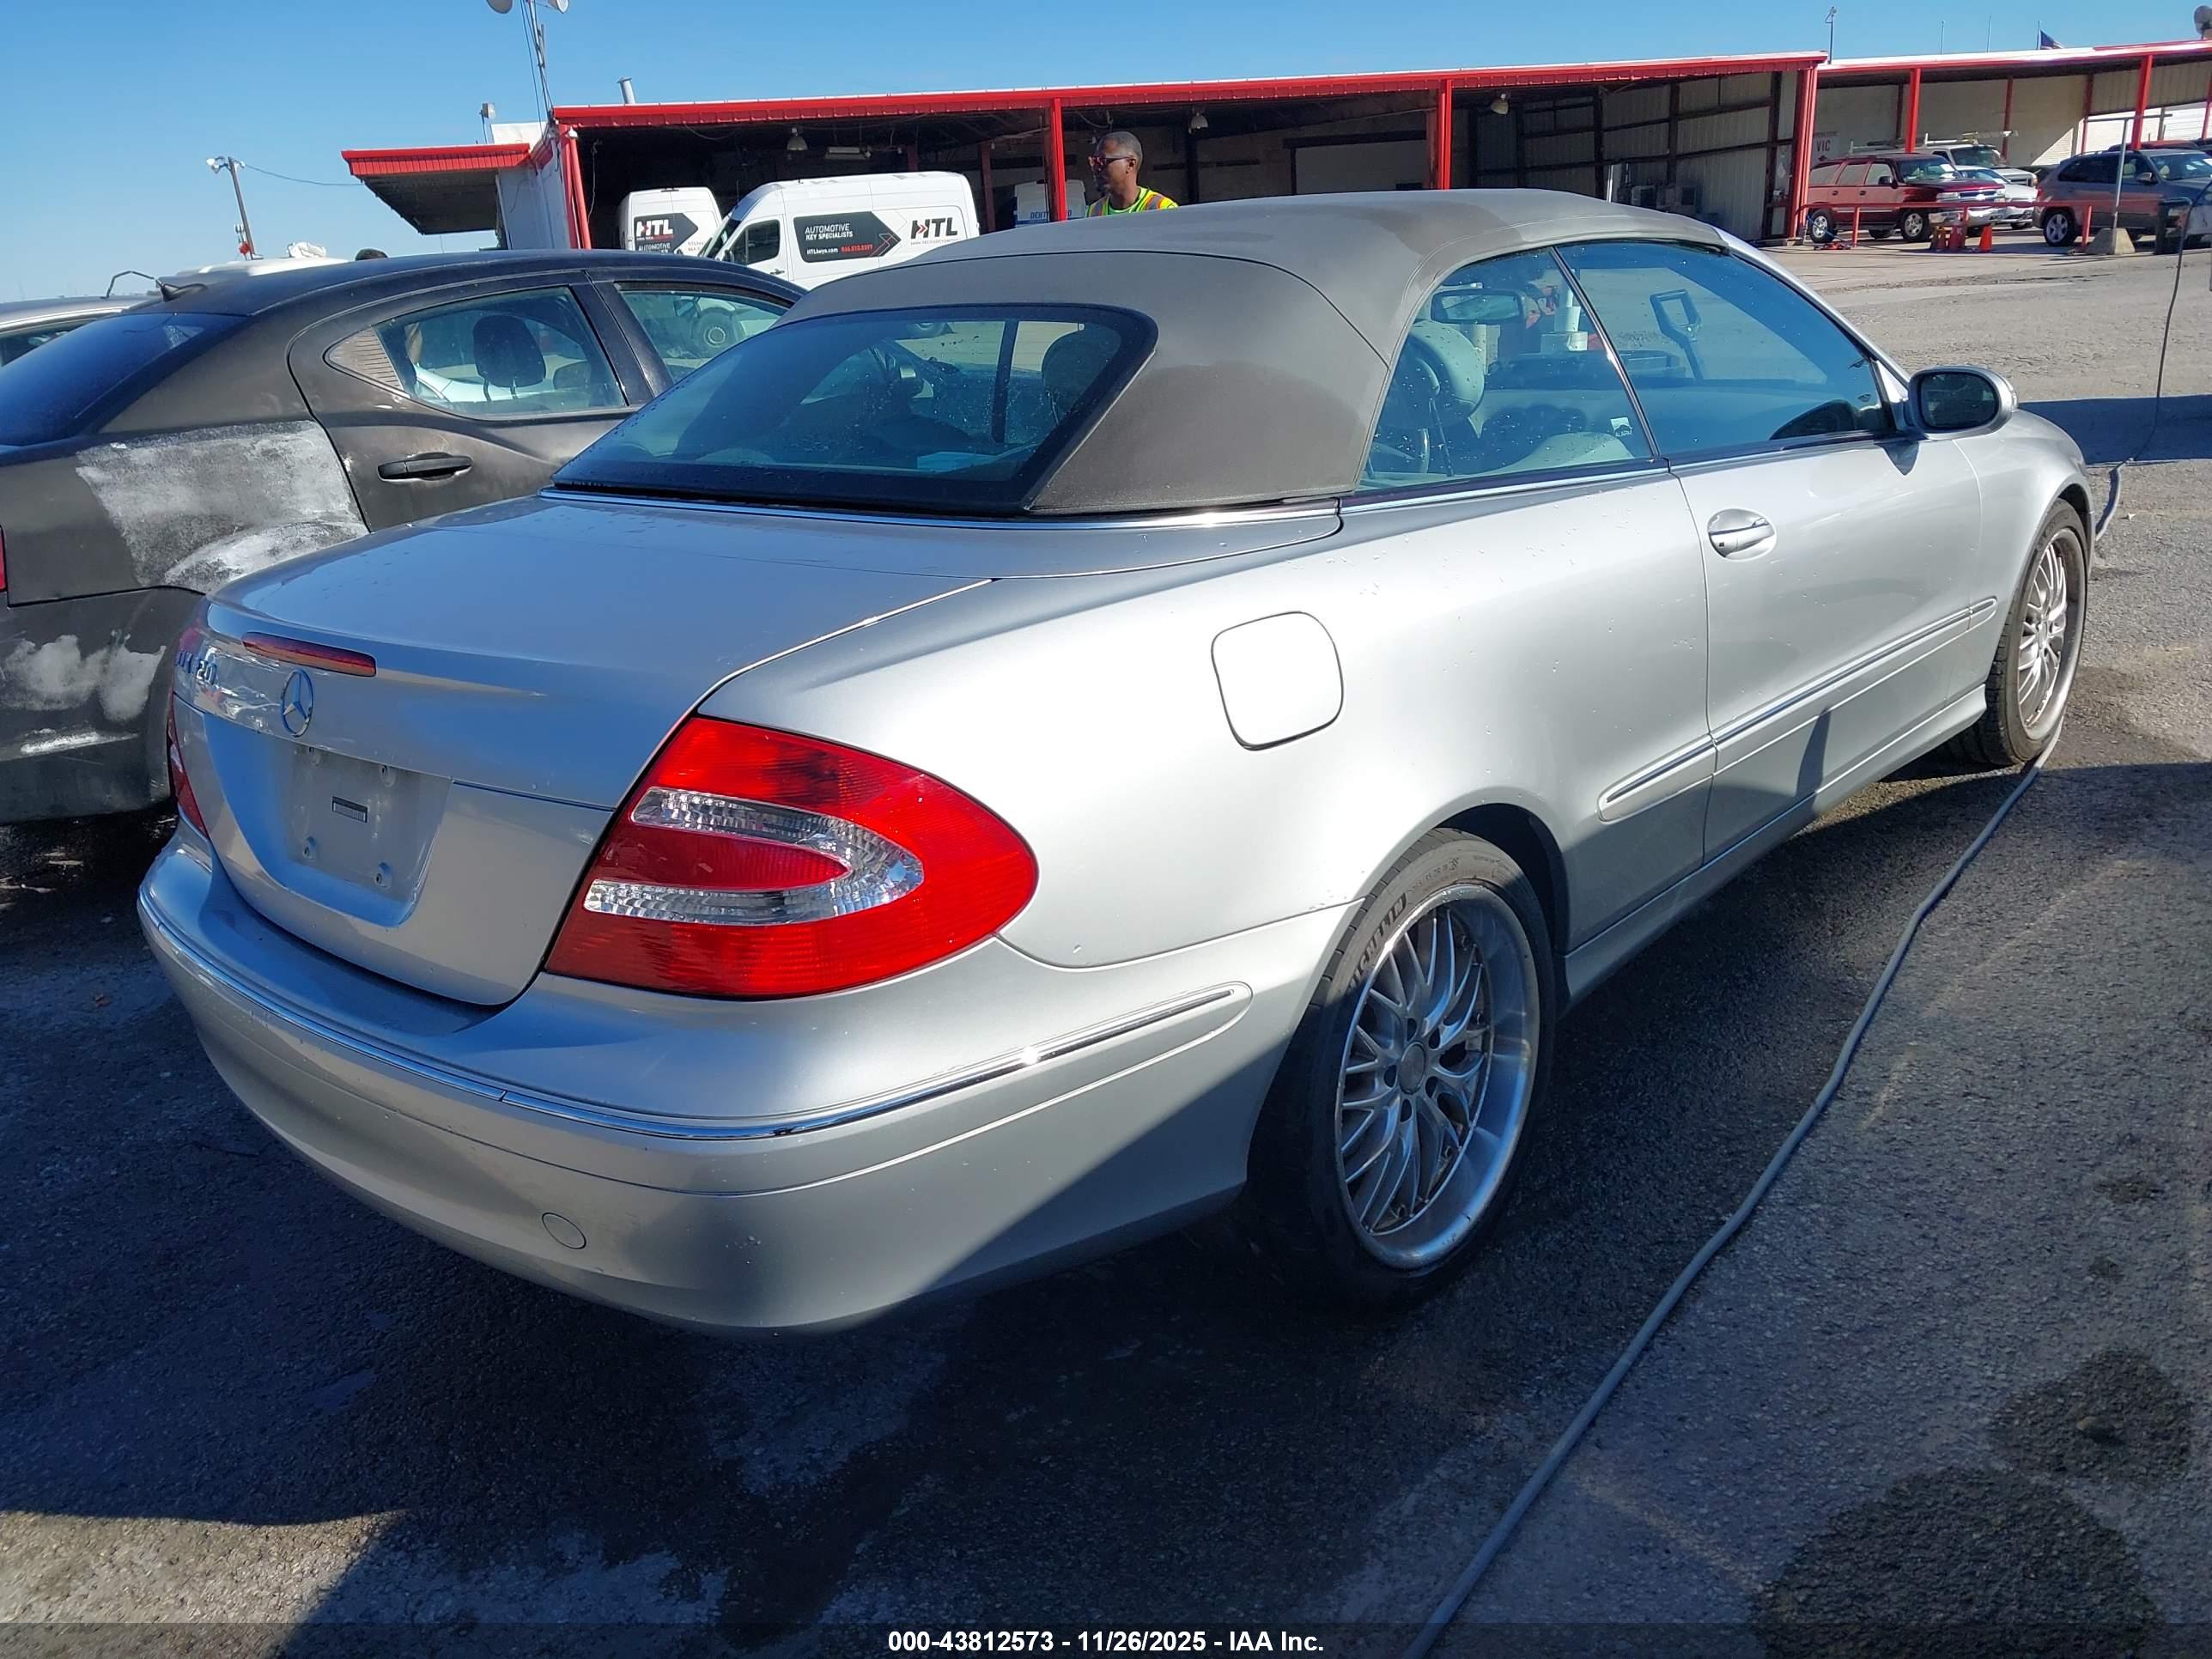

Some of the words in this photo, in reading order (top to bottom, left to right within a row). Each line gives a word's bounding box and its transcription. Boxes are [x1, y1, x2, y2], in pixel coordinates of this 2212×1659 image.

[636, 219, 673, 237] HTL
[805, 223, 850, 234] AUTOMOTIVE
[911, 217, 958, 239] HTL
[818, 231, 854, 240] SPECIALISTS
